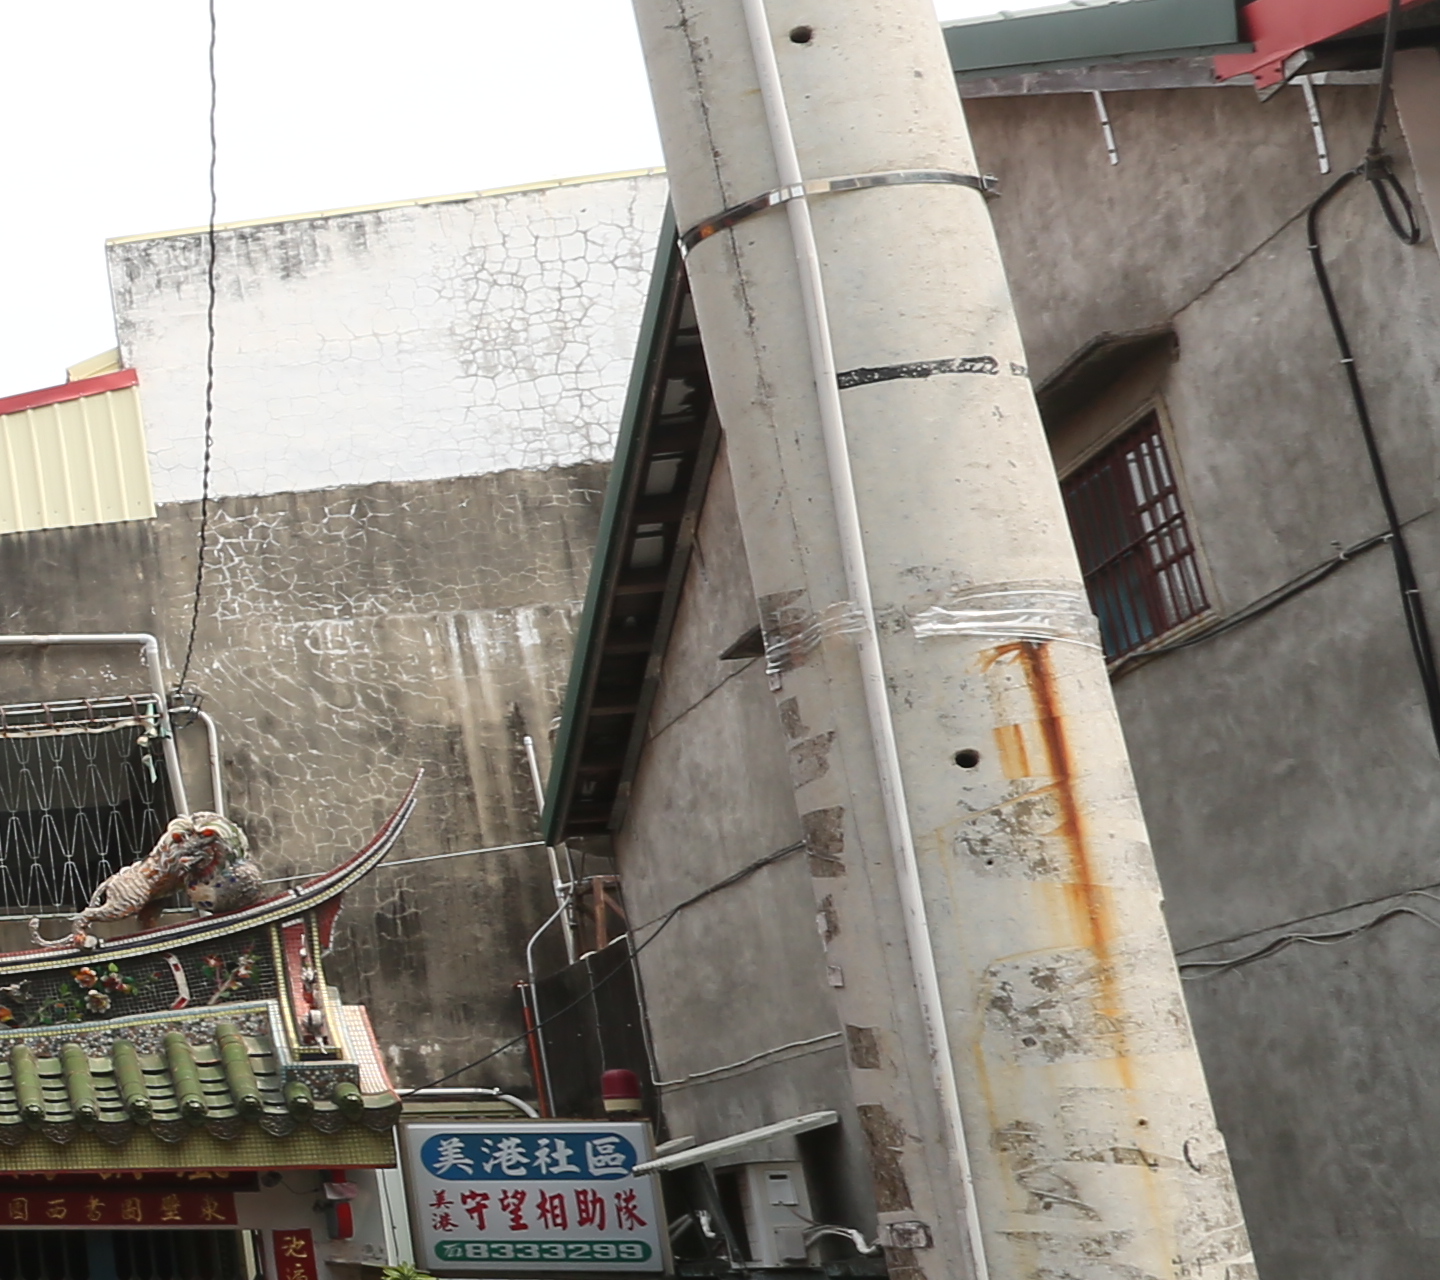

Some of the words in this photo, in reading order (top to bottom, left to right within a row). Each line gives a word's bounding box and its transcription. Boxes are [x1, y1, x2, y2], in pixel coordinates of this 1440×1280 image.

[431, 1135, 630, 1178] 美港社區
[428, 1188, 459, 1233] 美港
[459, 1187, 649, 1233] 守望相助隊
[464, 1242, 645, 1260] 8333299
